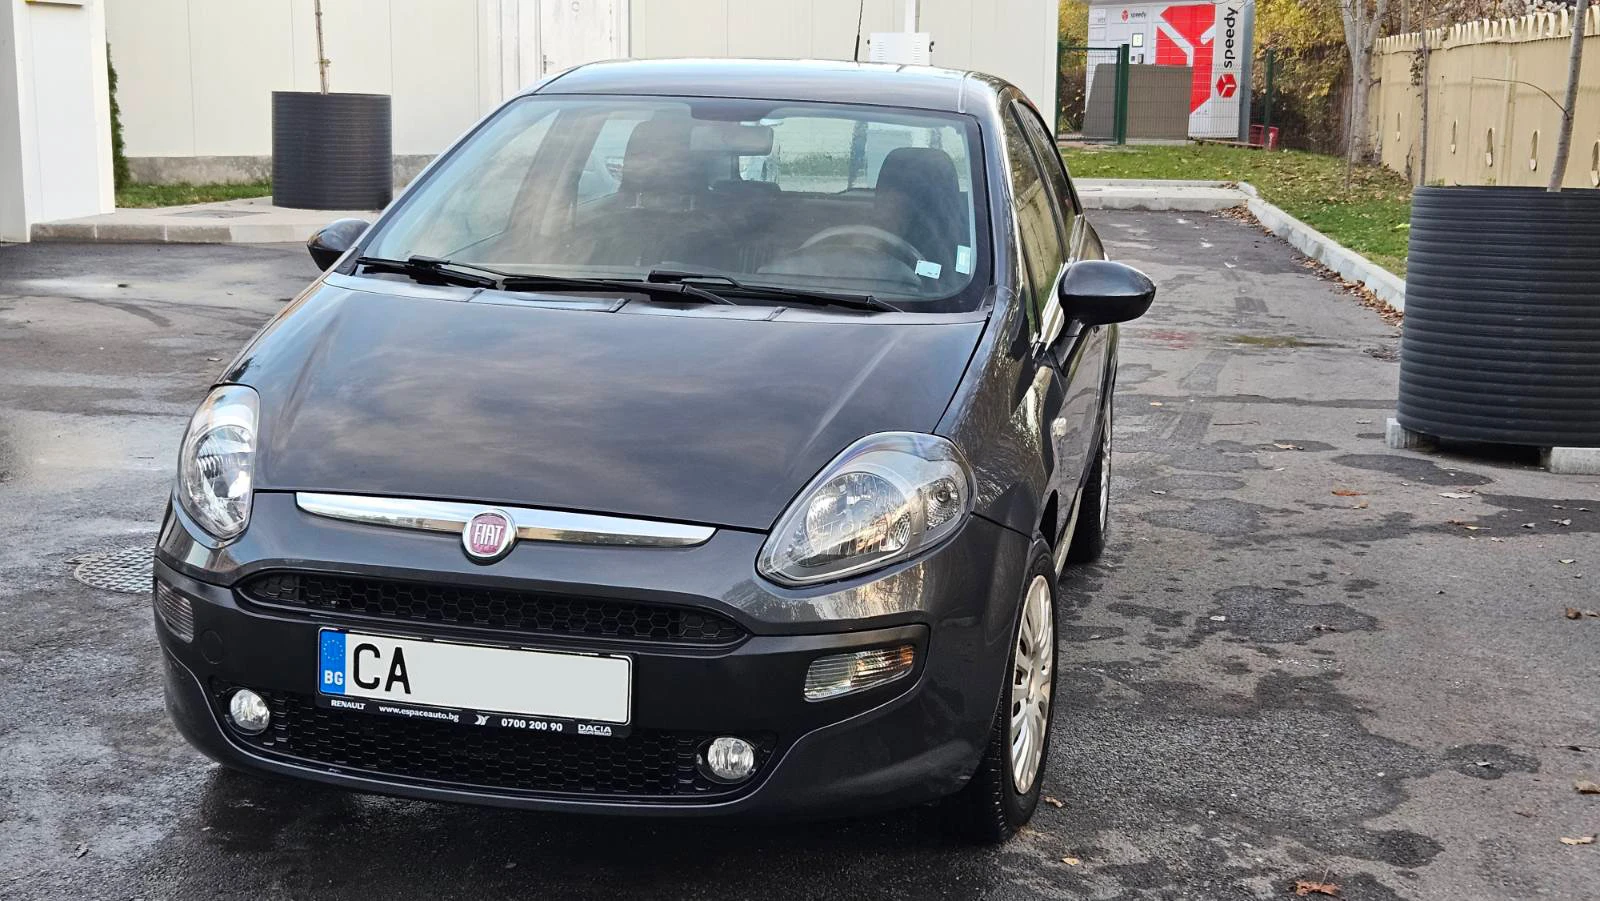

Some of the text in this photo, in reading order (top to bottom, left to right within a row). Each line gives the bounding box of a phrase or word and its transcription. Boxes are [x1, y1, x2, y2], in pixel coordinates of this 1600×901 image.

[1224, 7, 1238, 68] speedy
[474, 523, 503, 546] FIAT
[353, 643, 411, 694] CA
[324, 670, 344, 685] BG
[331, 700, 365, 710] RENAULT
[379, 705, 459, 722] www.espaceauto.bg
[501, 718, 563, 732] 0700 200 90
[577, 723, 612, 733] DACIA
